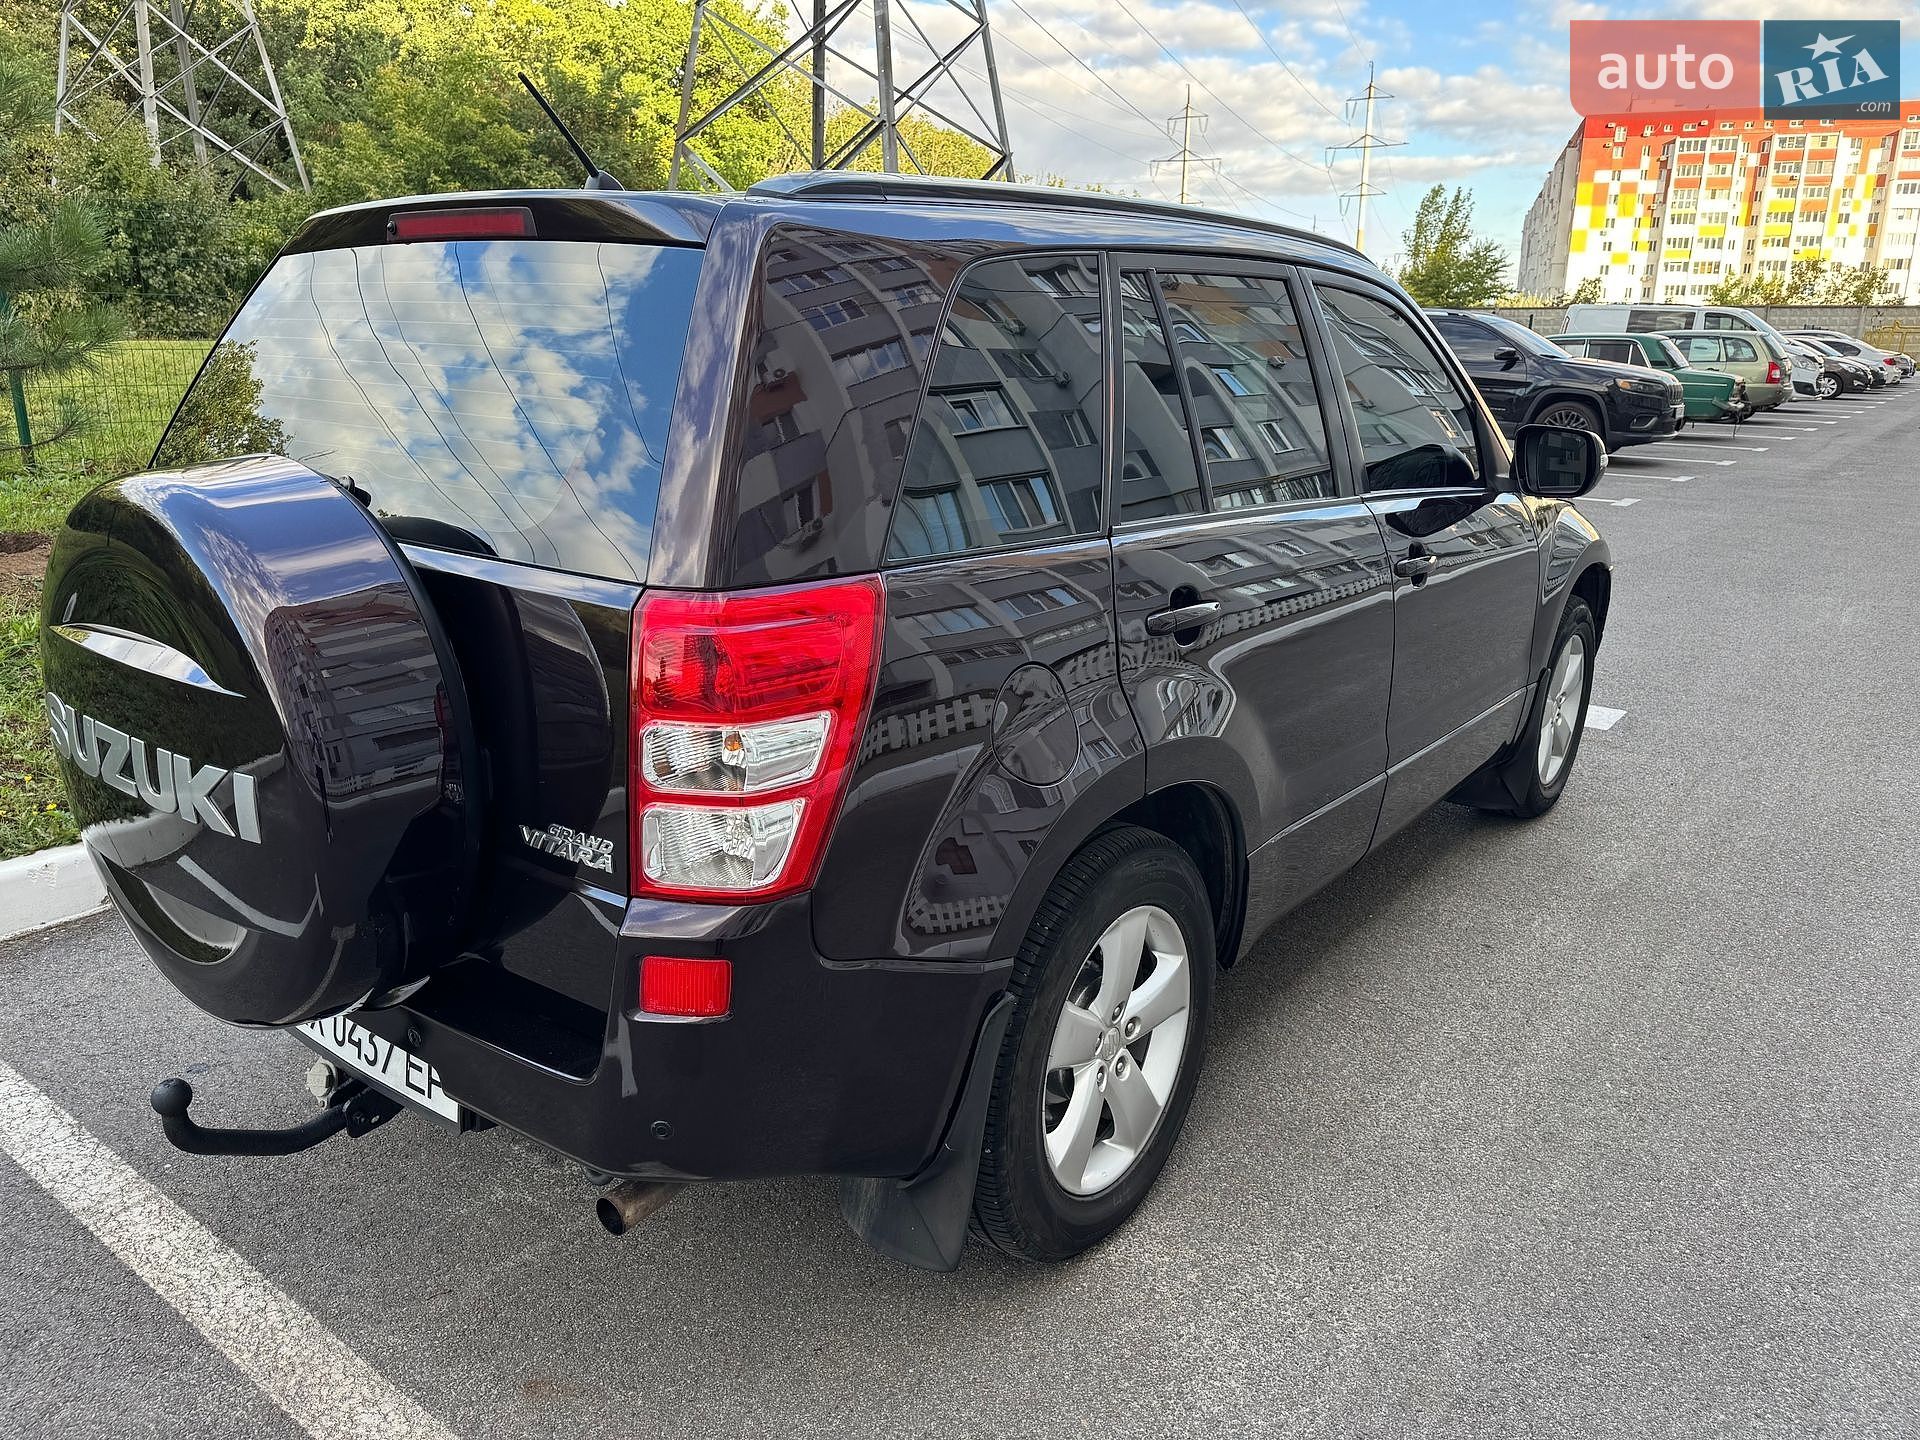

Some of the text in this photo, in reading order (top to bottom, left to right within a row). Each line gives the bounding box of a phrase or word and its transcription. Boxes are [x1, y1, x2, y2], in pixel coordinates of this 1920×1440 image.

[47, 691, 262, 844] SUZUKI
[518, 824, 613, 874] VITARA
[547, 823, 614, 854] GRAND
